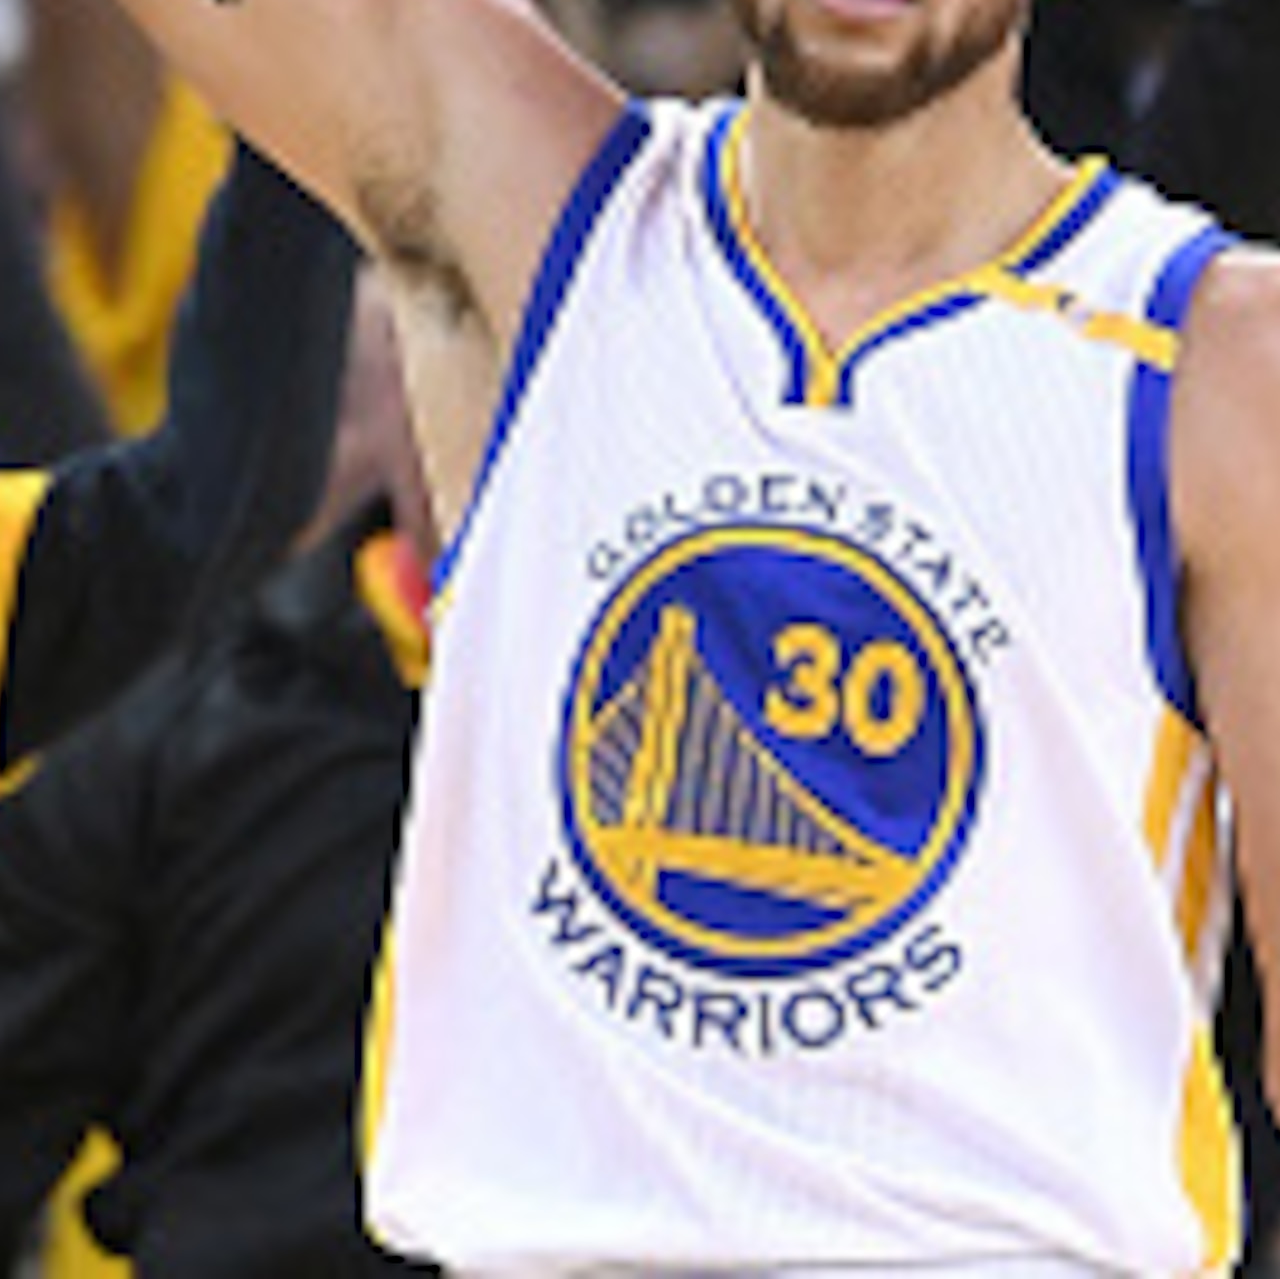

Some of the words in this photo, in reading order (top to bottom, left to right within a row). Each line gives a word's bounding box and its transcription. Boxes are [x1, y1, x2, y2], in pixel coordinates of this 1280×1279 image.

[587, 474, 847, 581] GOLDEN
[858, 502, 1011, 666] STATE
[764, 624, 926, 758] 30
[531, 858, 963, 1056] WARRIORS
